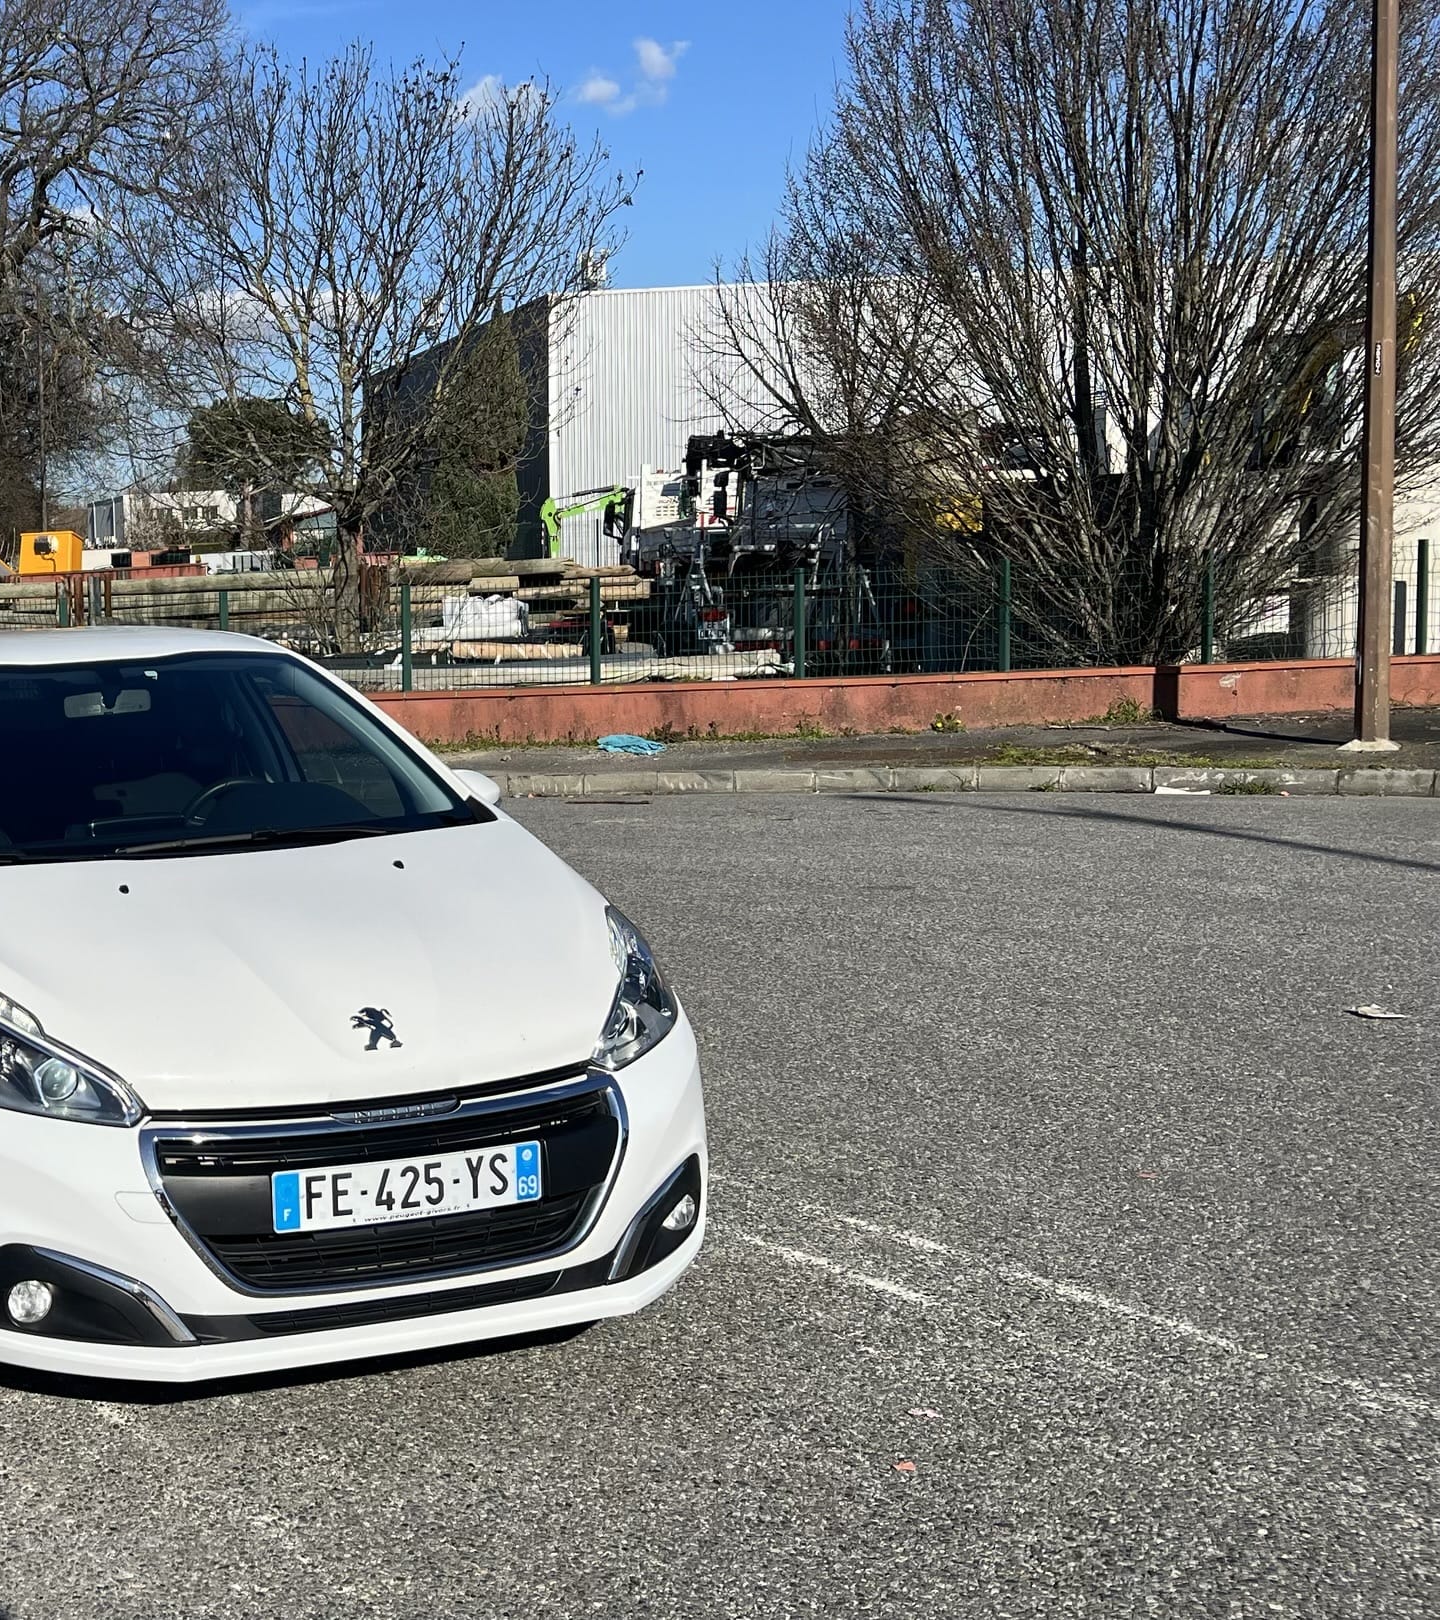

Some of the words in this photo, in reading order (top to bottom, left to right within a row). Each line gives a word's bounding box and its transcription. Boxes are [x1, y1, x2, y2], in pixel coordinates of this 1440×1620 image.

[305, 1153, 509, 1219] FE-425-YS
[517, 1174, 538, 1196] 69
[283, 1208, 291, 1222] F
